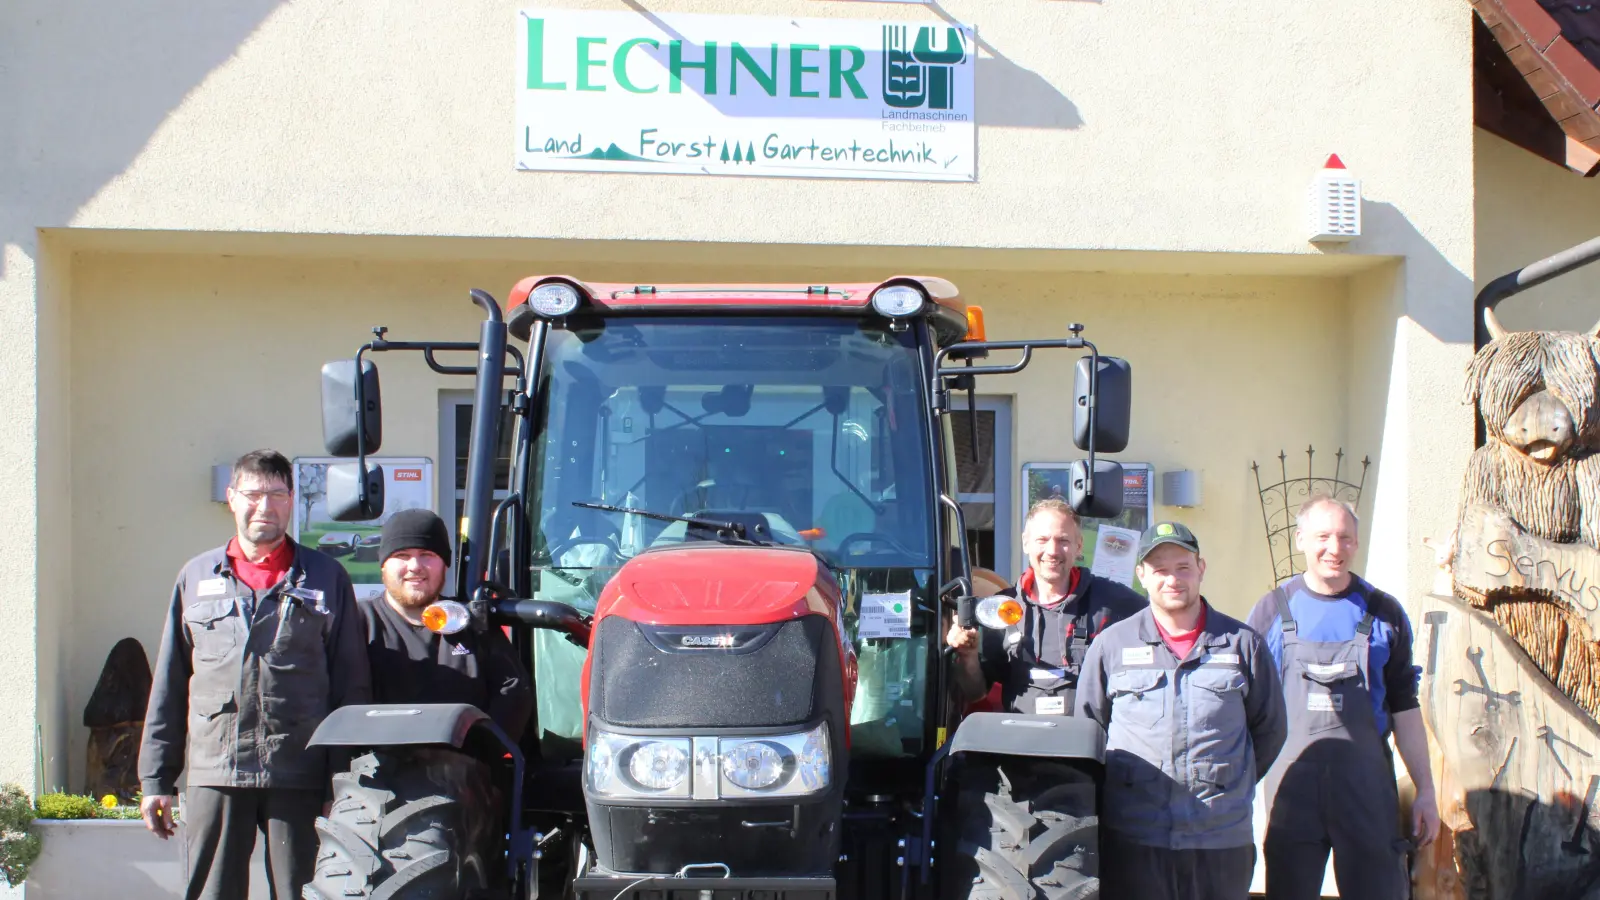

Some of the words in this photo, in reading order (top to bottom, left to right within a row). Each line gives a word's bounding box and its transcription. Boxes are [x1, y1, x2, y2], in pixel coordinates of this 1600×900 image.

[526, 18, 869, 100] LECHNER
[881, 108, 968, 121] Landmaschinen
[881, 121, 946, 133] Fachbetrieb
[525, 125, 582, 154] Land
[640, 128, 717, 157] Forst
[762, 133, 937, 164] Gartentechnik
